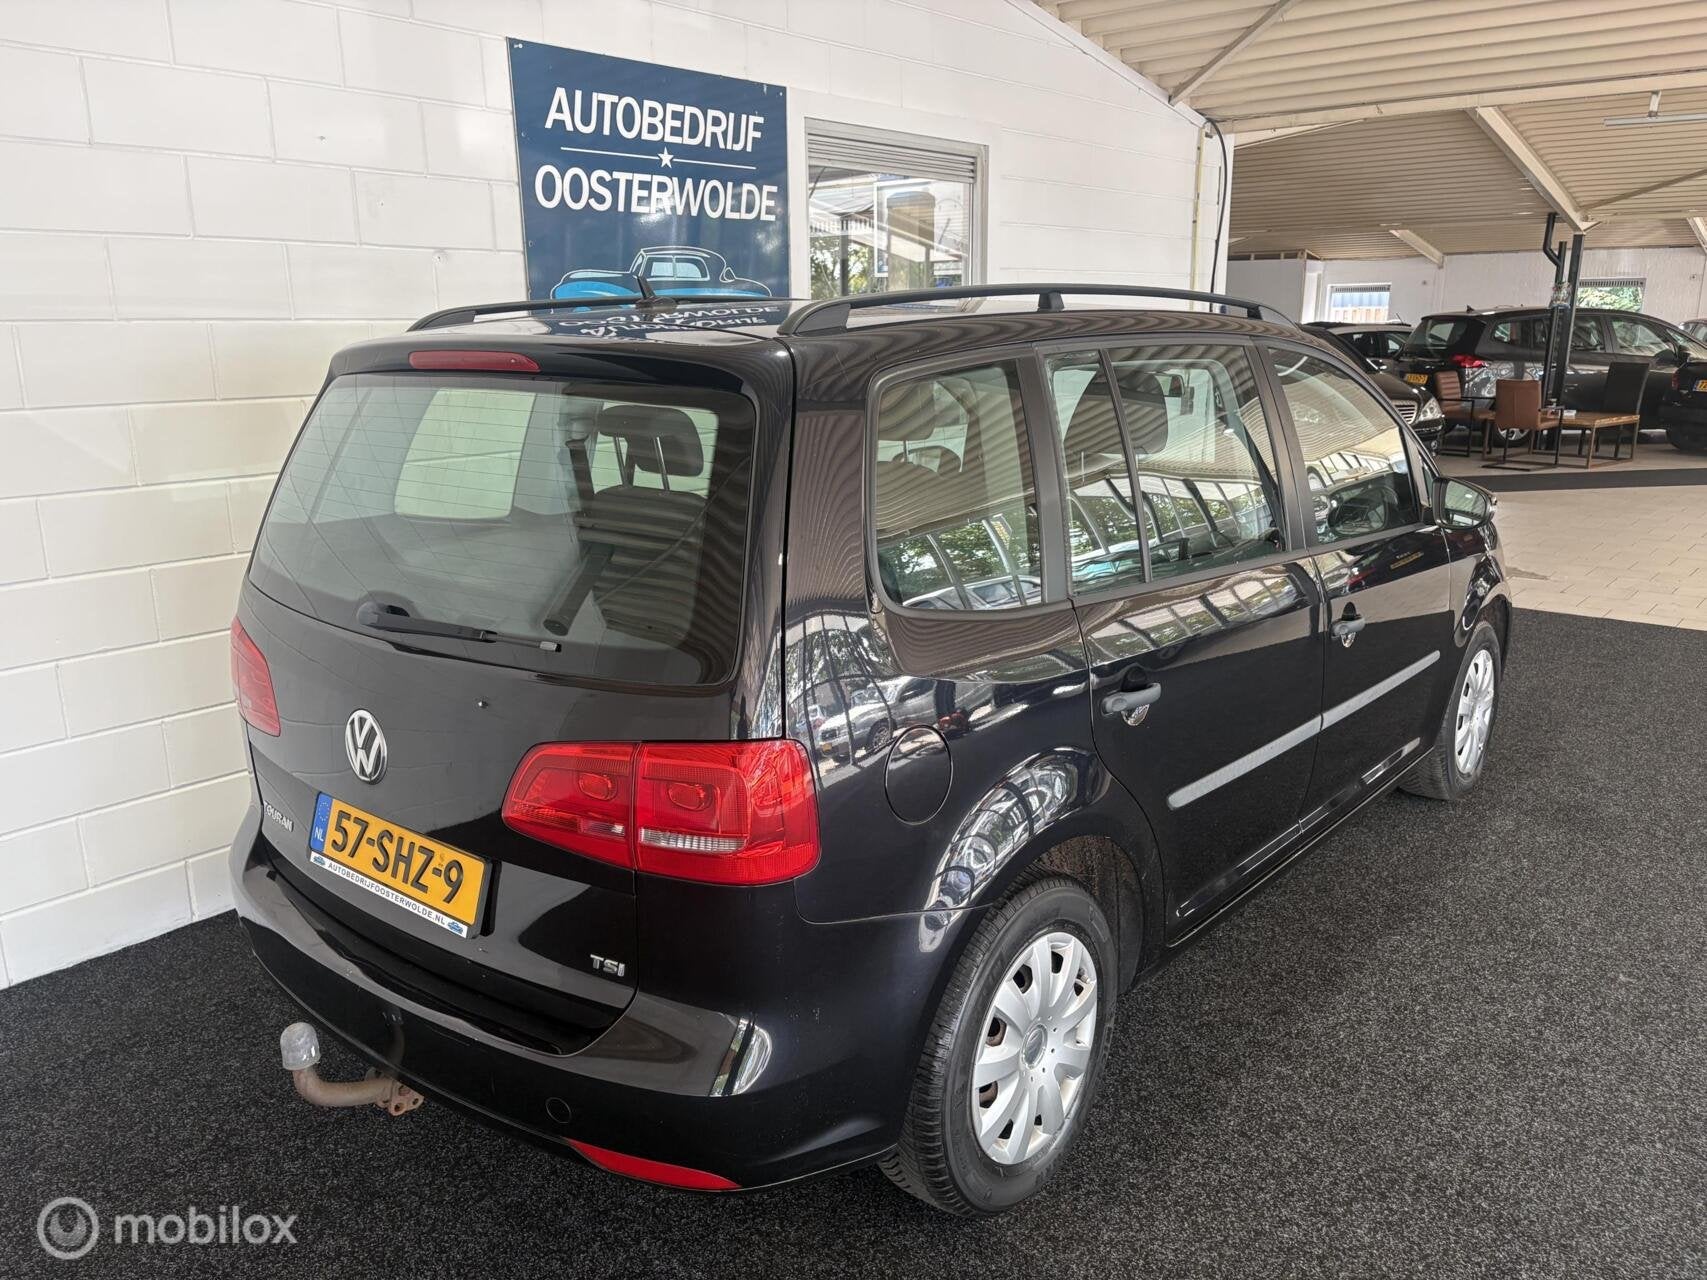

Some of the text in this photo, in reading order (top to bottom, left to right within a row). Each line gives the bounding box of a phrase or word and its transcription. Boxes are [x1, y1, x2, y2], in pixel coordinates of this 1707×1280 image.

[544, 86, 765, 153] AUTOBEDRIJF
[534, 164, 779, 222] OOSTERWOLDE
[263, 801, 294, 832] TOURAN
[314, 826, 325, 843] NL
[330, 809, 464, 905] 57-SHZ-9
[327, 862, 446, 926] AUTOBEDRIJFOOSTERWOLDE.NL
[590, 954, 625, 976] TSI
